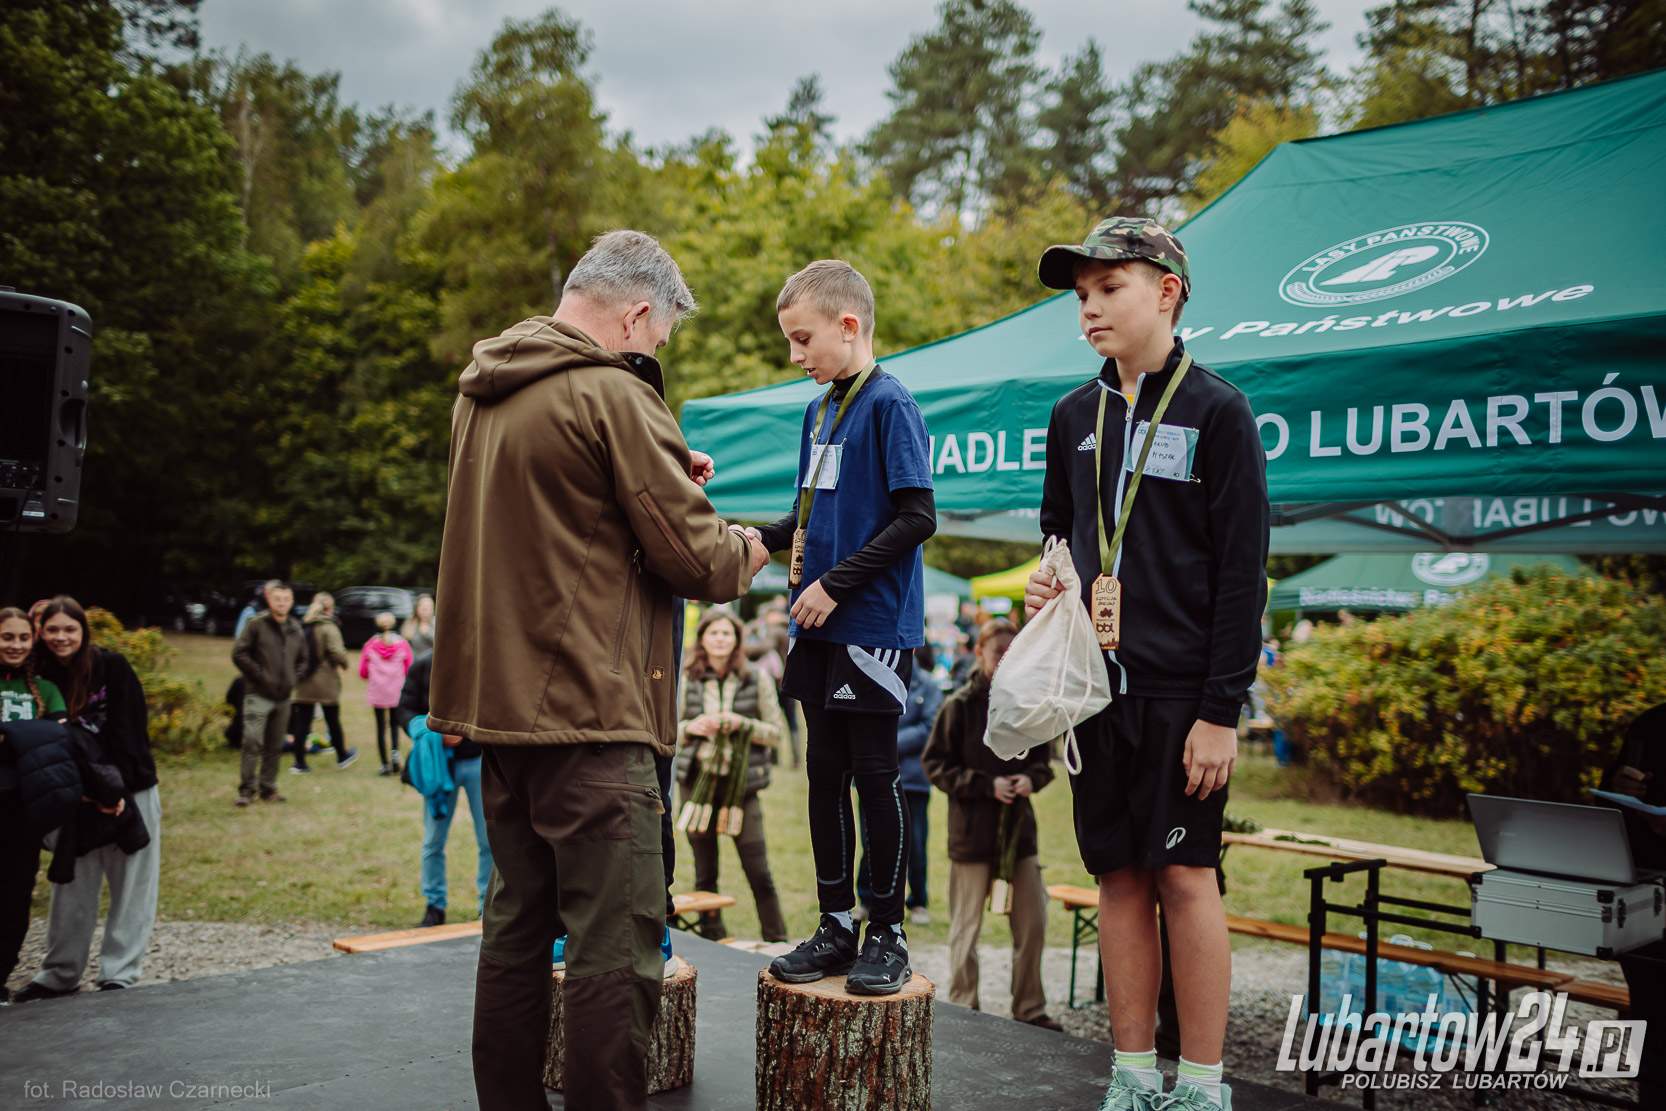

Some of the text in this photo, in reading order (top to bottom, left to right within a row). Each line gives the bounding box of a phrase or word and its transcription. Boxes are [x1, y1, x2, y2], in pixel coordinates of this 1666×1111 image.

[1302, 242, 1358, 272] LASY
[1219, 284, 1595, 341] Państwowe
[929, 427, 1048, 475] ADLE
[1096, 579, 1117, 594] 10
